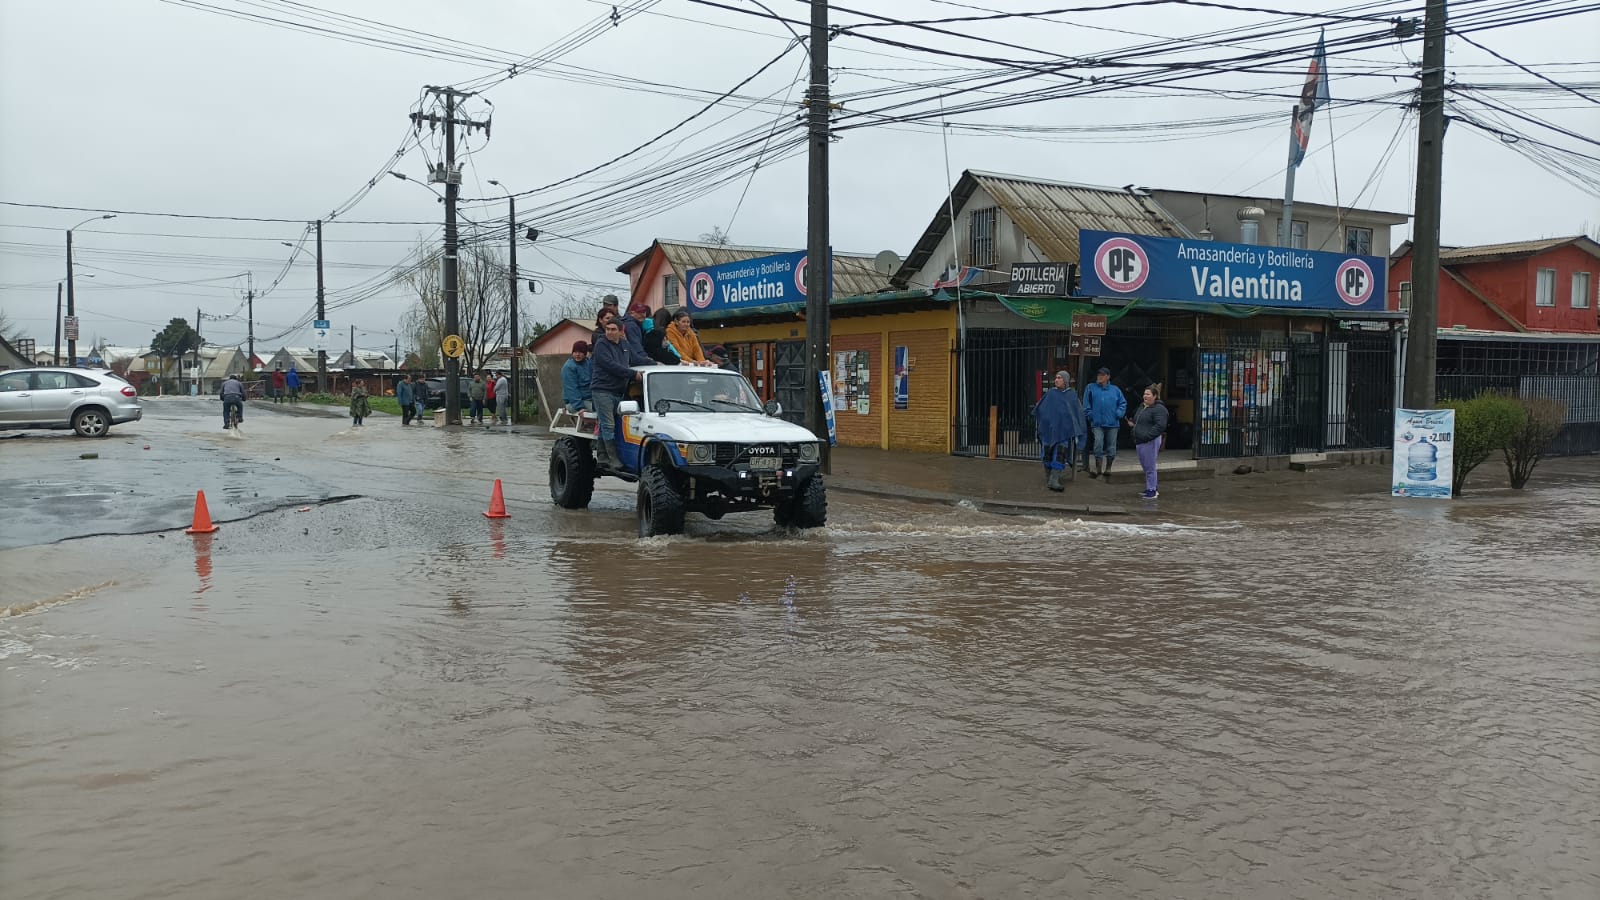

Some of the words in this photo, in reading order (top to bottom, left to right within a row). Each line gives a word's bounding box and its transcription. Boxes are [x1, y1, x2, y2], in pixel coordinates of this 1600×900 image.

[1109, 248, 1136, 282] PF
[1178, 242, 1255, 264] Amasandería
[1258, 253, 1265, 269] y
[1267, 250, 1314, 269] Botillería
[755, 266, 760, 278] y
[1191, 266, 1302, 301] Valentina
[1345, 267, 1365, 297] PF
[696, 279, 708, 301] PF
[722, 278, 784, 304] Valentina
[1017, 283, 1056, 294] ABIERTO
